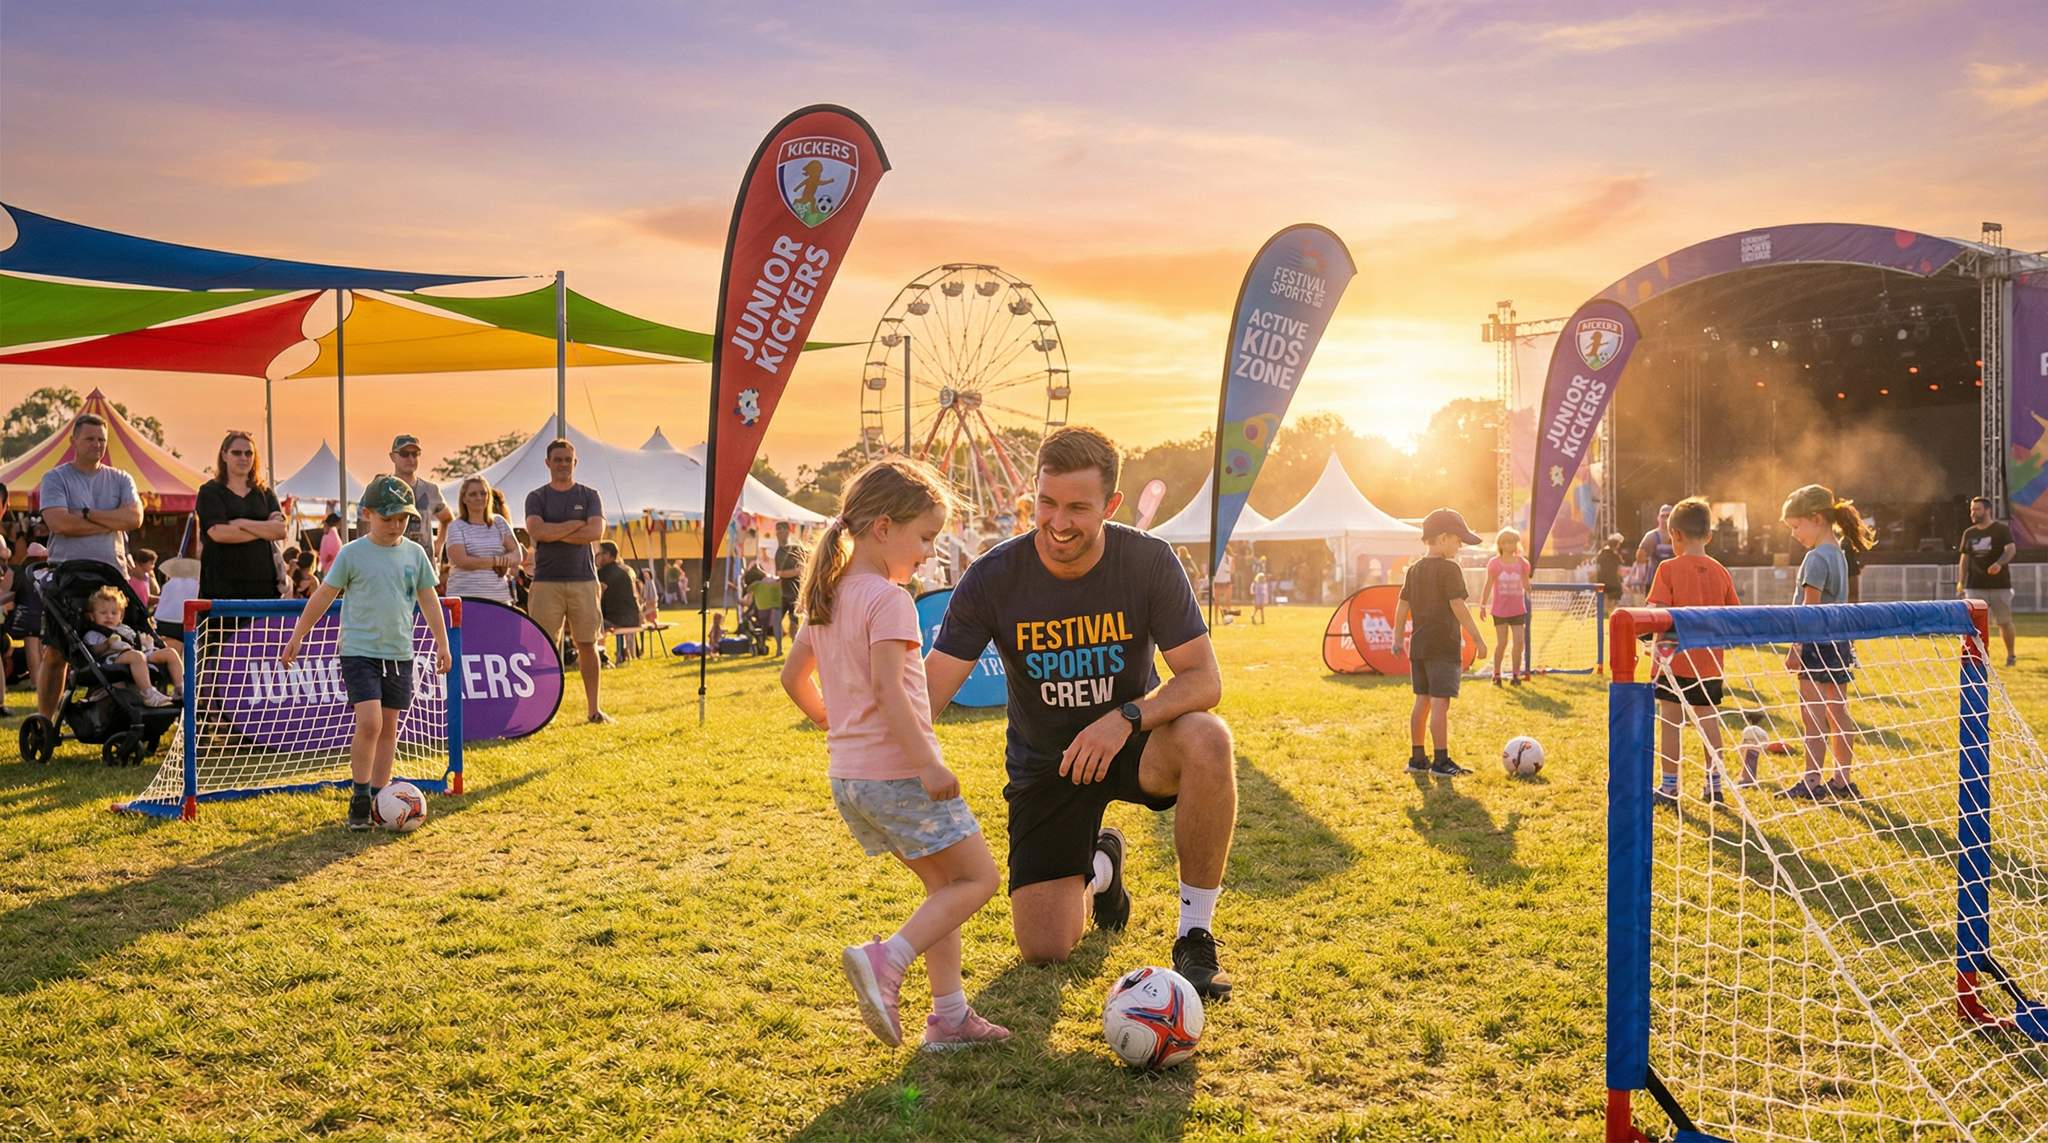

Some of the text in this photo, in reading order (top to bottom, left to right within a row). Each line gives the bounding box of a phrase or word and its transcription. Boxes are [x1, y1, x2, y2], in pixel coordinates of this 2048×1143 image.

[787, 141, 850, 159] KICKERS
[731, 235, 803, 361] JUNIOR
[1270, 281, 1313, 304] SPORTS
[1273, 266, 1326, 294] FESTIVAL
[755, 244, 830, 374] KICKERS
[1249, 308, 1309, 340] ACTIVE
[1241, 327, 1304, 367] KIDS
[1235, 354, 1295, 390] ZONE
[1546, 374, 1590, 449] JUNIOR
[1561, 379, 1607, 458] KICKERS
[1016, 611, 1133, 651] FESTIVAL
[1025, 644, 1125, 680] SPORTS
[1040, 676, 1114, 708] CREW
